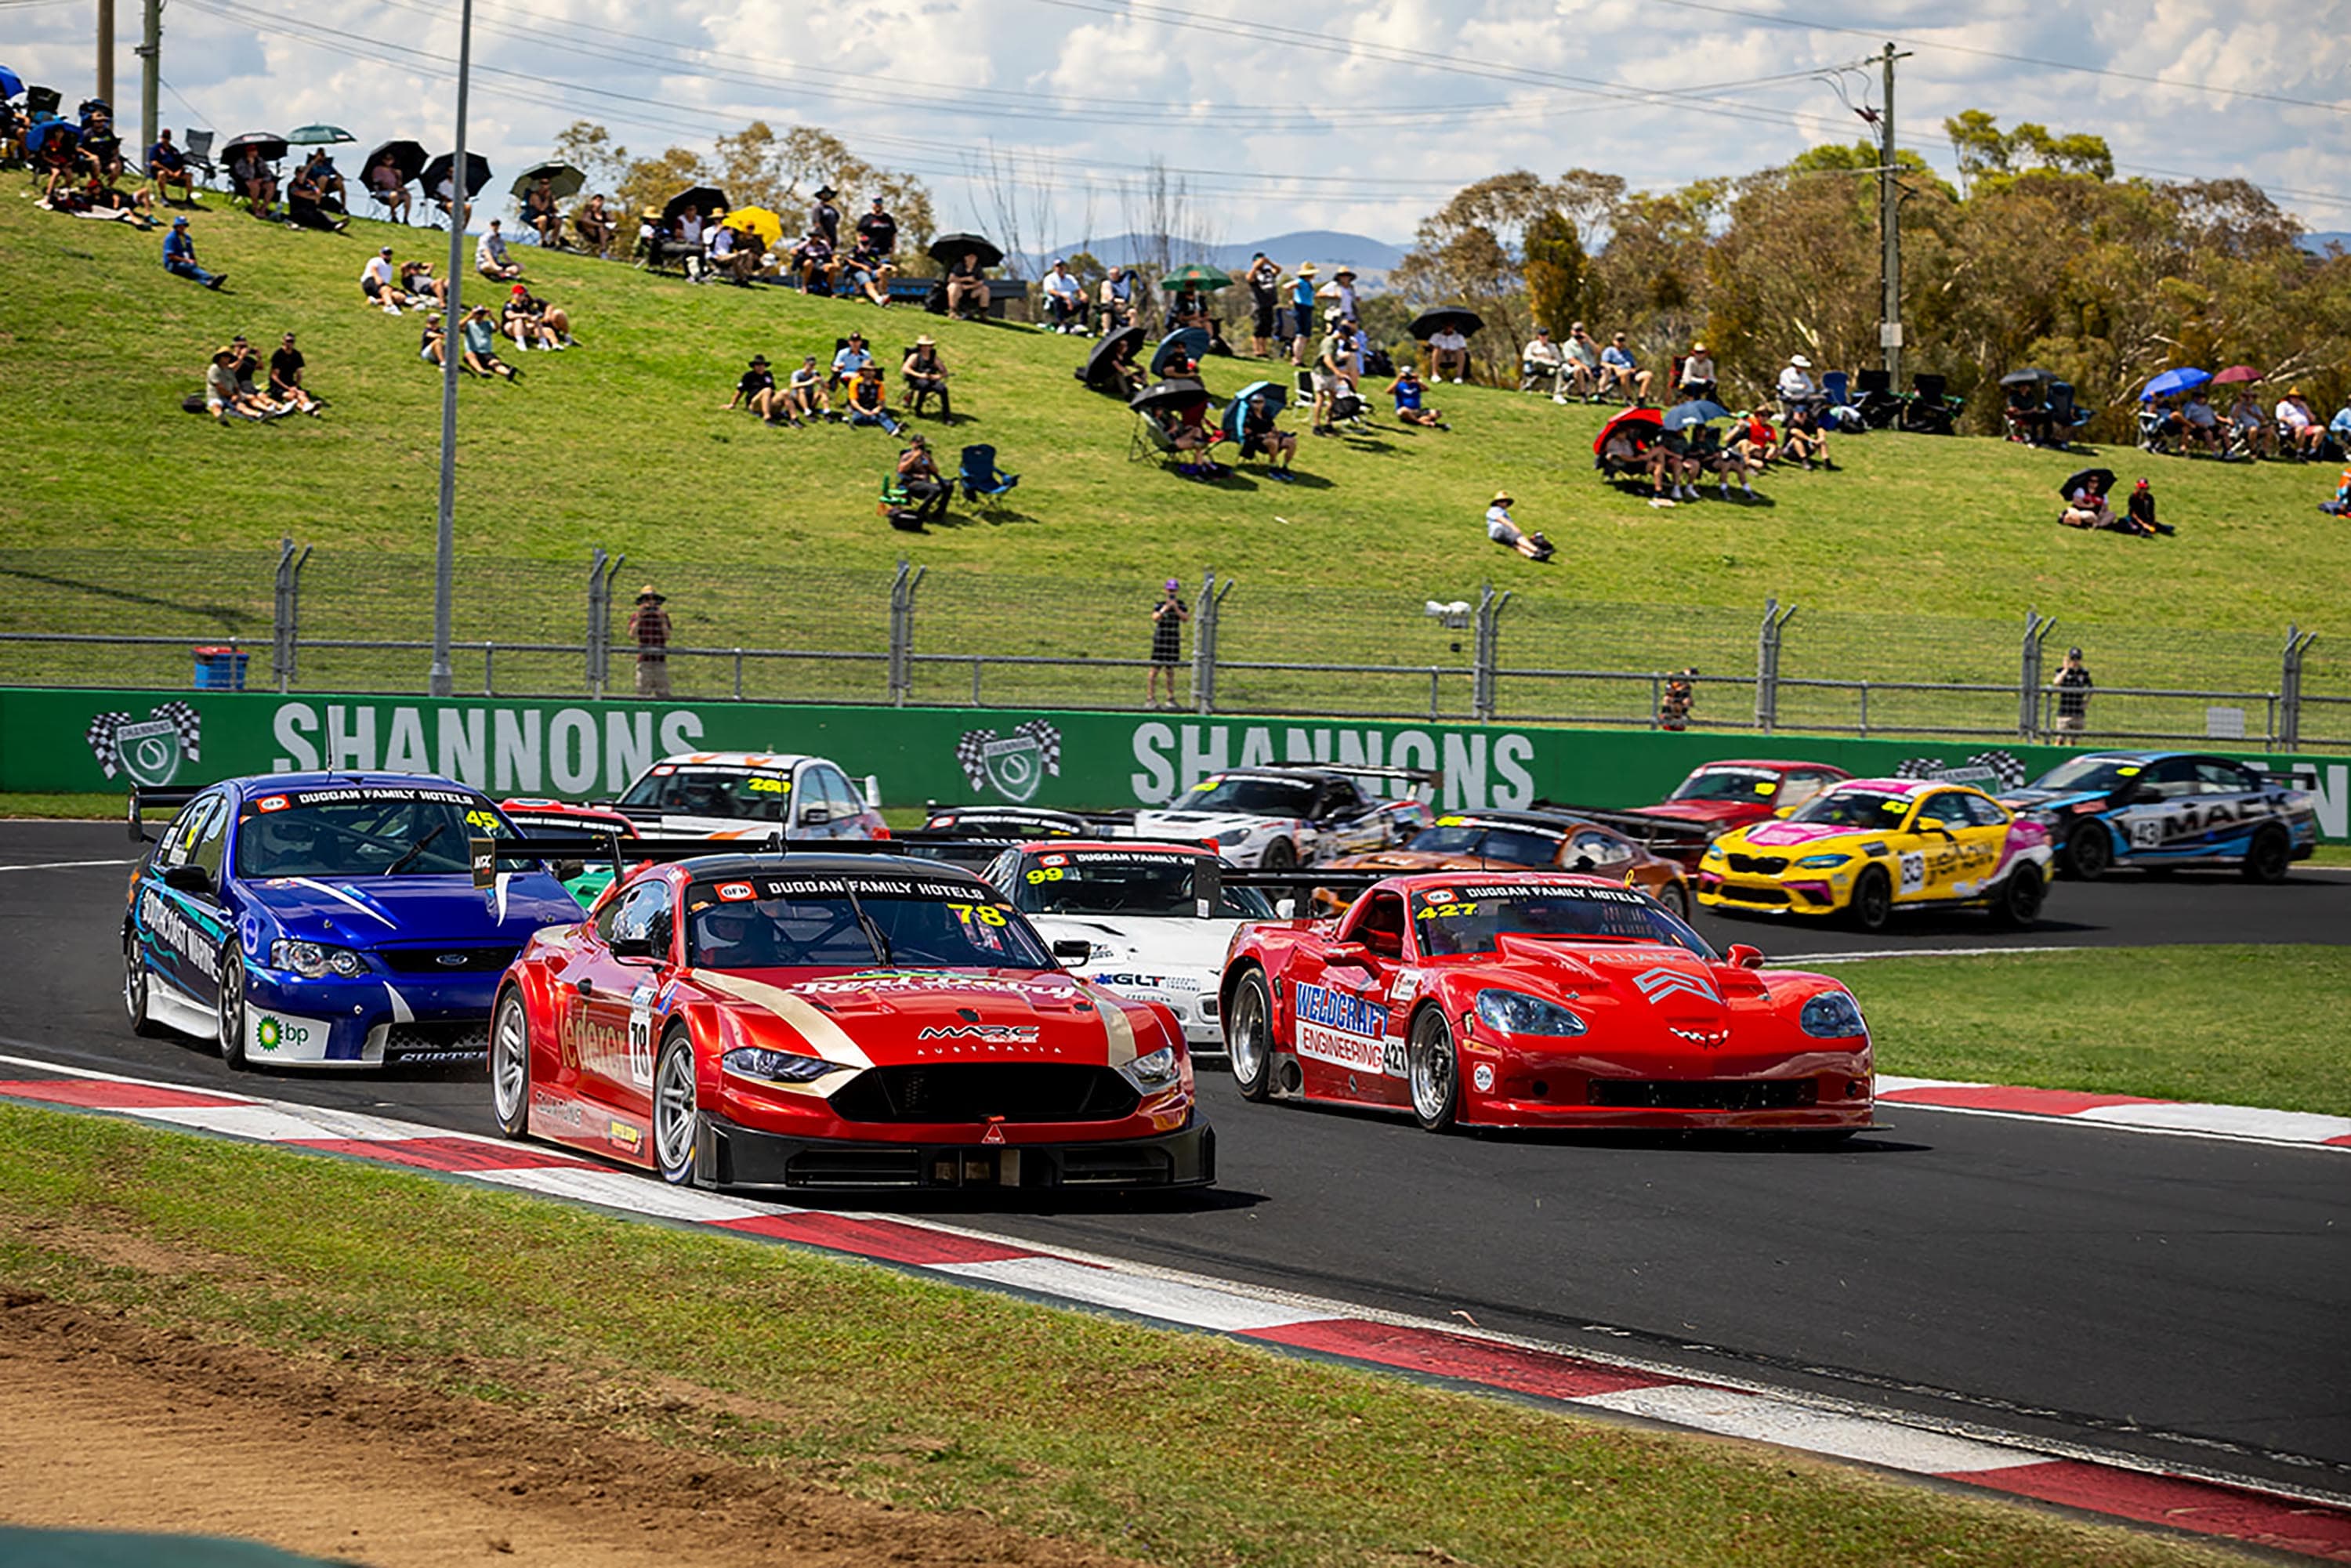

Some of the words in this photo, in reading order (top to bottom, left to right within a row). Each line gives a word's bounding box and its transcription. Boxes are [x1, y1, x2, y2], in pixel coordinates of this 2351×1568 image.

[273, 702, 705, 793] SHANNONS
[299, 789, 360, 804] DUGGAN
[364, 789, 416, 799] FAMILY
[419, 791, 474, 806] HOTELS
[465, 809, 500, 829] 45
[1076, 853, 1128, 863] DUGGAN
[1132, 854, 1178, 864] FAMILY
[1026, 867, 1063, 885] 99
[768, 881, 844, 894] DUGGAN
[848, 881, 912, 894] FAMILY
[918, 883, 986, 900] HOTELS
[1466, 886, 1528, 897] DUGGAN
[1533, 887, 1585, 899] FAMILY
[1588, 890, 1645, 904] HOTELS
[947, 903, 1007, 927] 78
[1416, 903, 1479, 921] 427
[1114, 973, 1166, 987] GLT
[1296, 983, 1389, 1037] WELDCRAFT
[285, 1023, 309, 1045] bp
[630, 1022, 650, 1077] 78
[1302, 1027, 1382, 1068] ENGINEERING
[1383, 1042, 1408, 1071] 427
